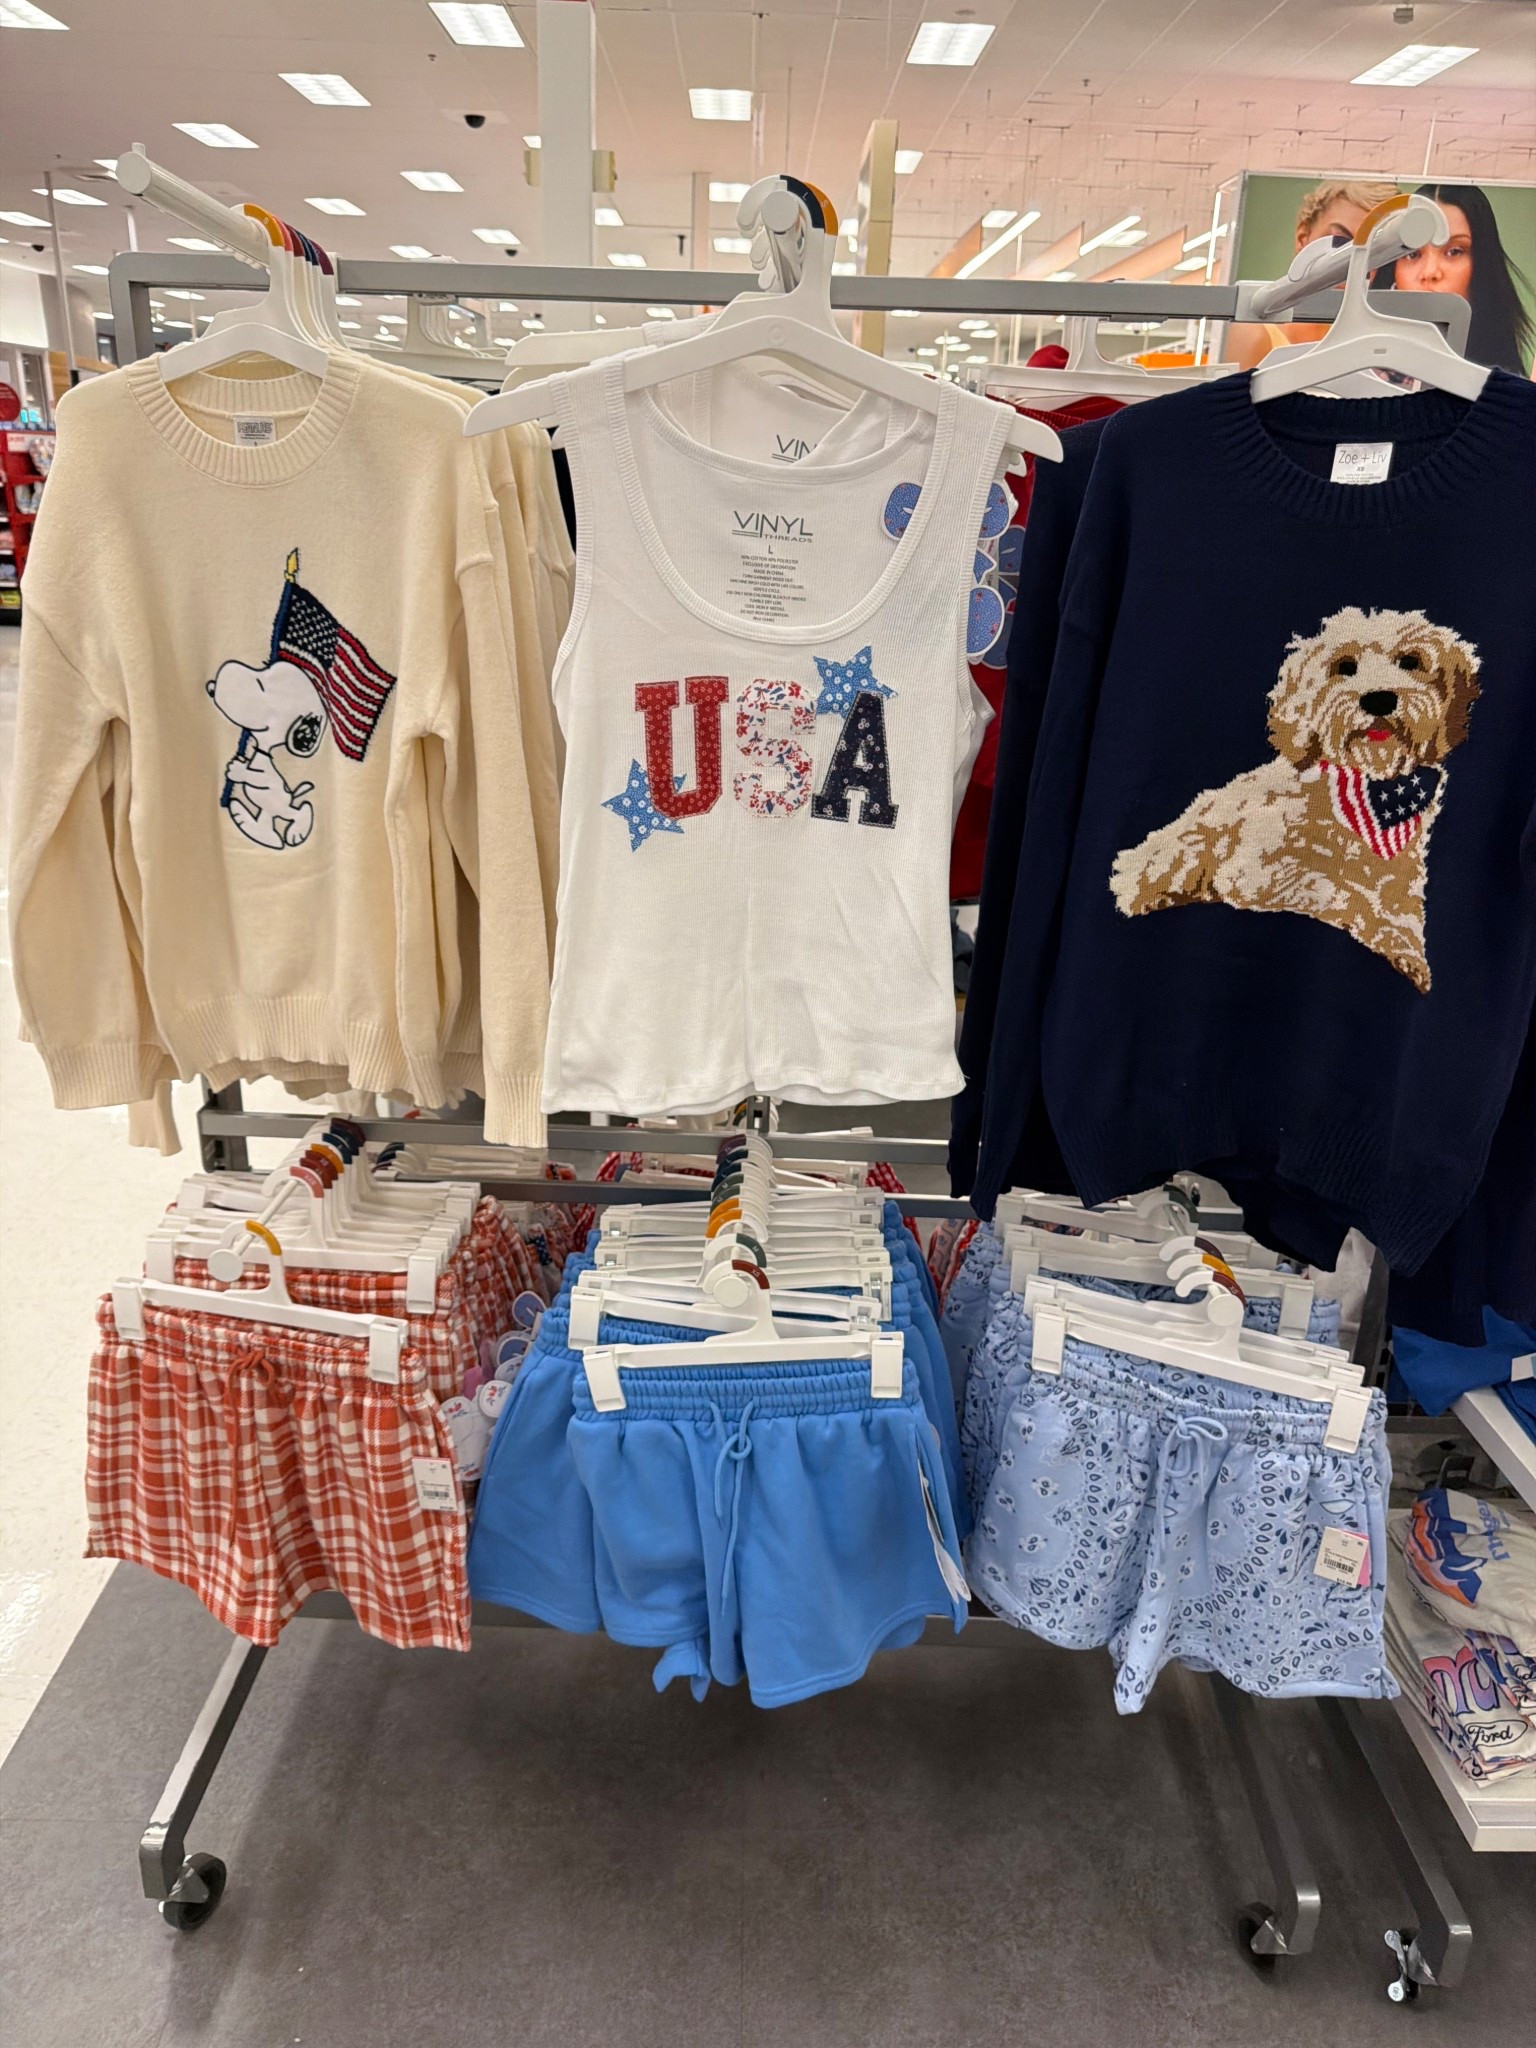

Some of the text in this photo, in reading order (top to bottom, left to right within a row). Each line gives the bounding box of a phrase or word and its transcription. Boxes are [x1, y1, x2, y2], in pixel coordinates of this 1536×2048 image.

[802, 191, 809, 201] L
[821, 199, 829, 208] S
[1338, 450, 1358, 464] Zoe
[1372, 450, 1387, 464] Liv
[733, 510, 814, 538] VINYL
[763, 534, 813, 543] THREADS
[768, 545, 773, 555] L
[635, 675, 899, 829] USA
[1467, 1723, 1514, 1750] Ford
